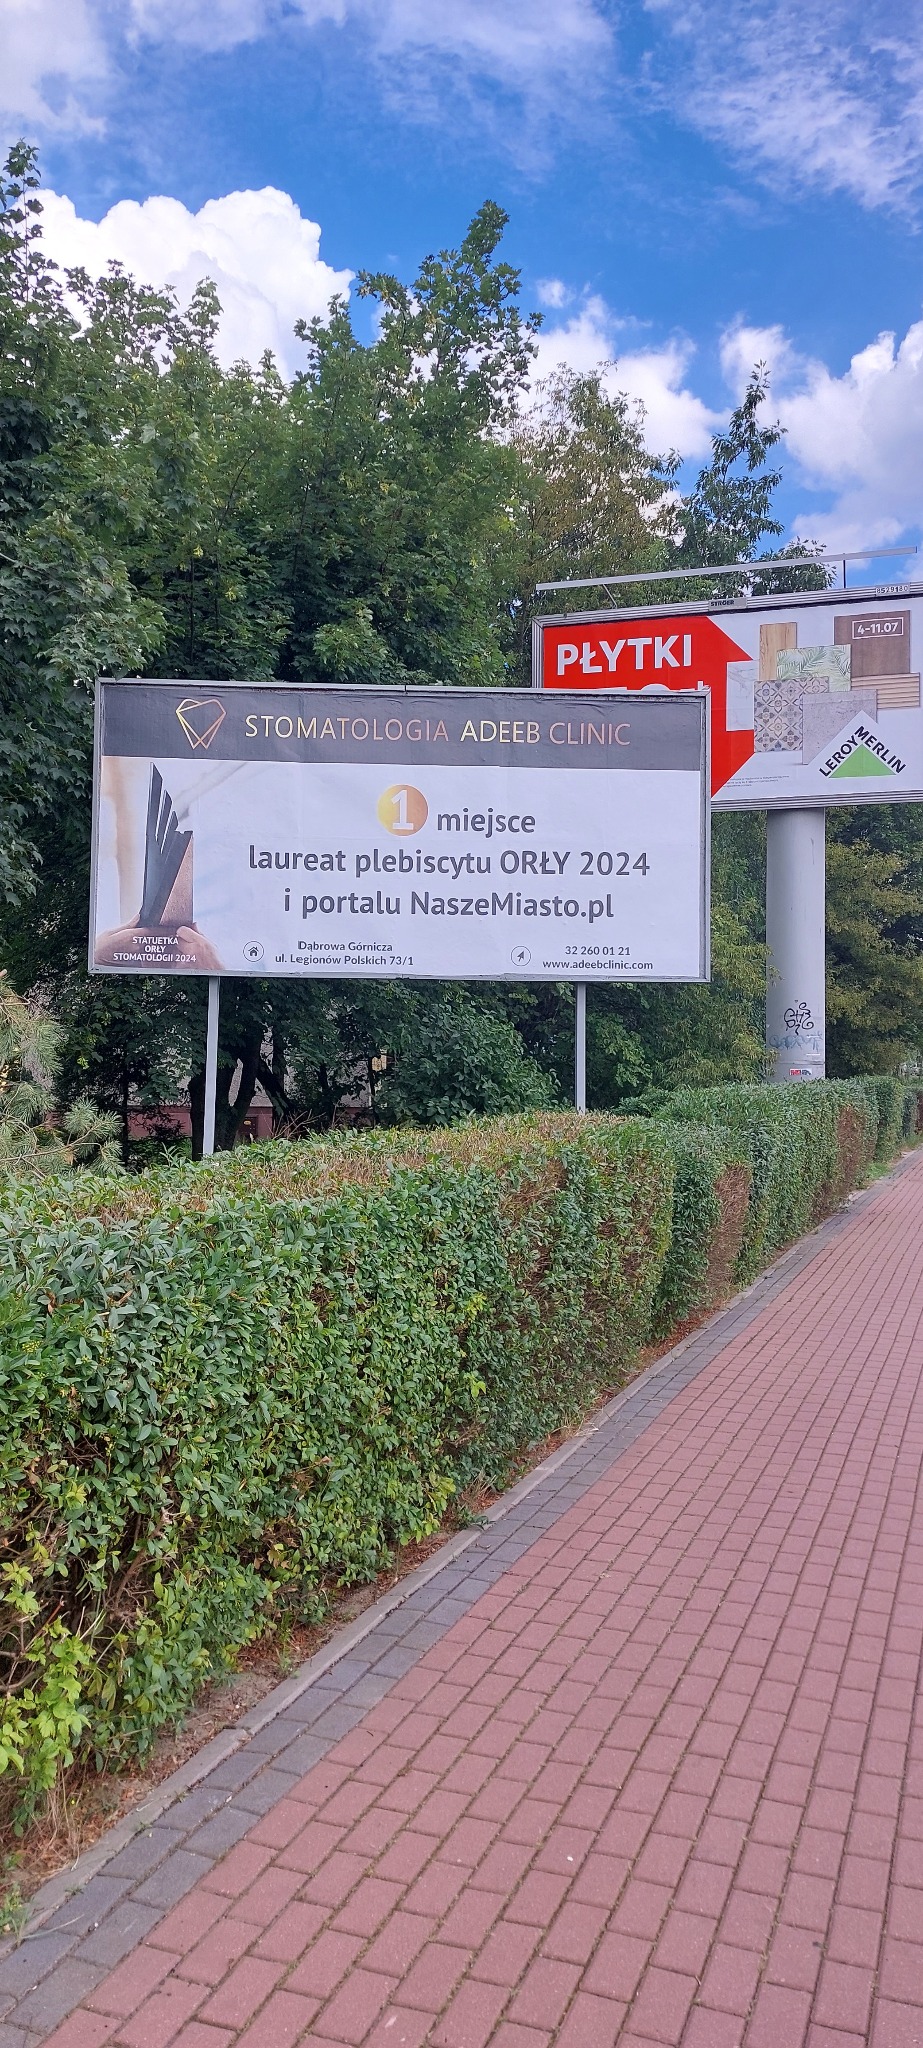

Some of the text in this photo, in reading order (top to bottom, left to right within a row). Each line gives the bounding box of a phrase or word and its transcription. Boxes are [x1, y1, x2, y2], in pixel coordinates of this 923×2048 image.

[857, 622, 899, 634] 4-11.07
[557, 634, 692, 676] PŁYTKI
[245, 714, 631, 746] STOMATOLOGIA ADEEB CLINIC
[819, 725, 907, 777] LEROY MERLIN
[390, 789, 536, 838] 1 miejsce
[249, 845, 650, 880] laureat plebiscytu ORŁY 2024
[284, 887, 614, 923] i portalu NaszeMiasto.pl
[132, 936, 179, 945] STATUETKA
[297, 940, 393, 952] Dąbrowa Górnicza
[144, 945, 166, 953] ORŁY
[565, 945, 631, 956] 32 260 01 21
[113, 952, 197, 963] STOMATOLOGII 2024
[275, 953, 414, 966] ul. Legionów Polskich 73/1
[542, 960, 653, 970] www.adeebclinic.com
